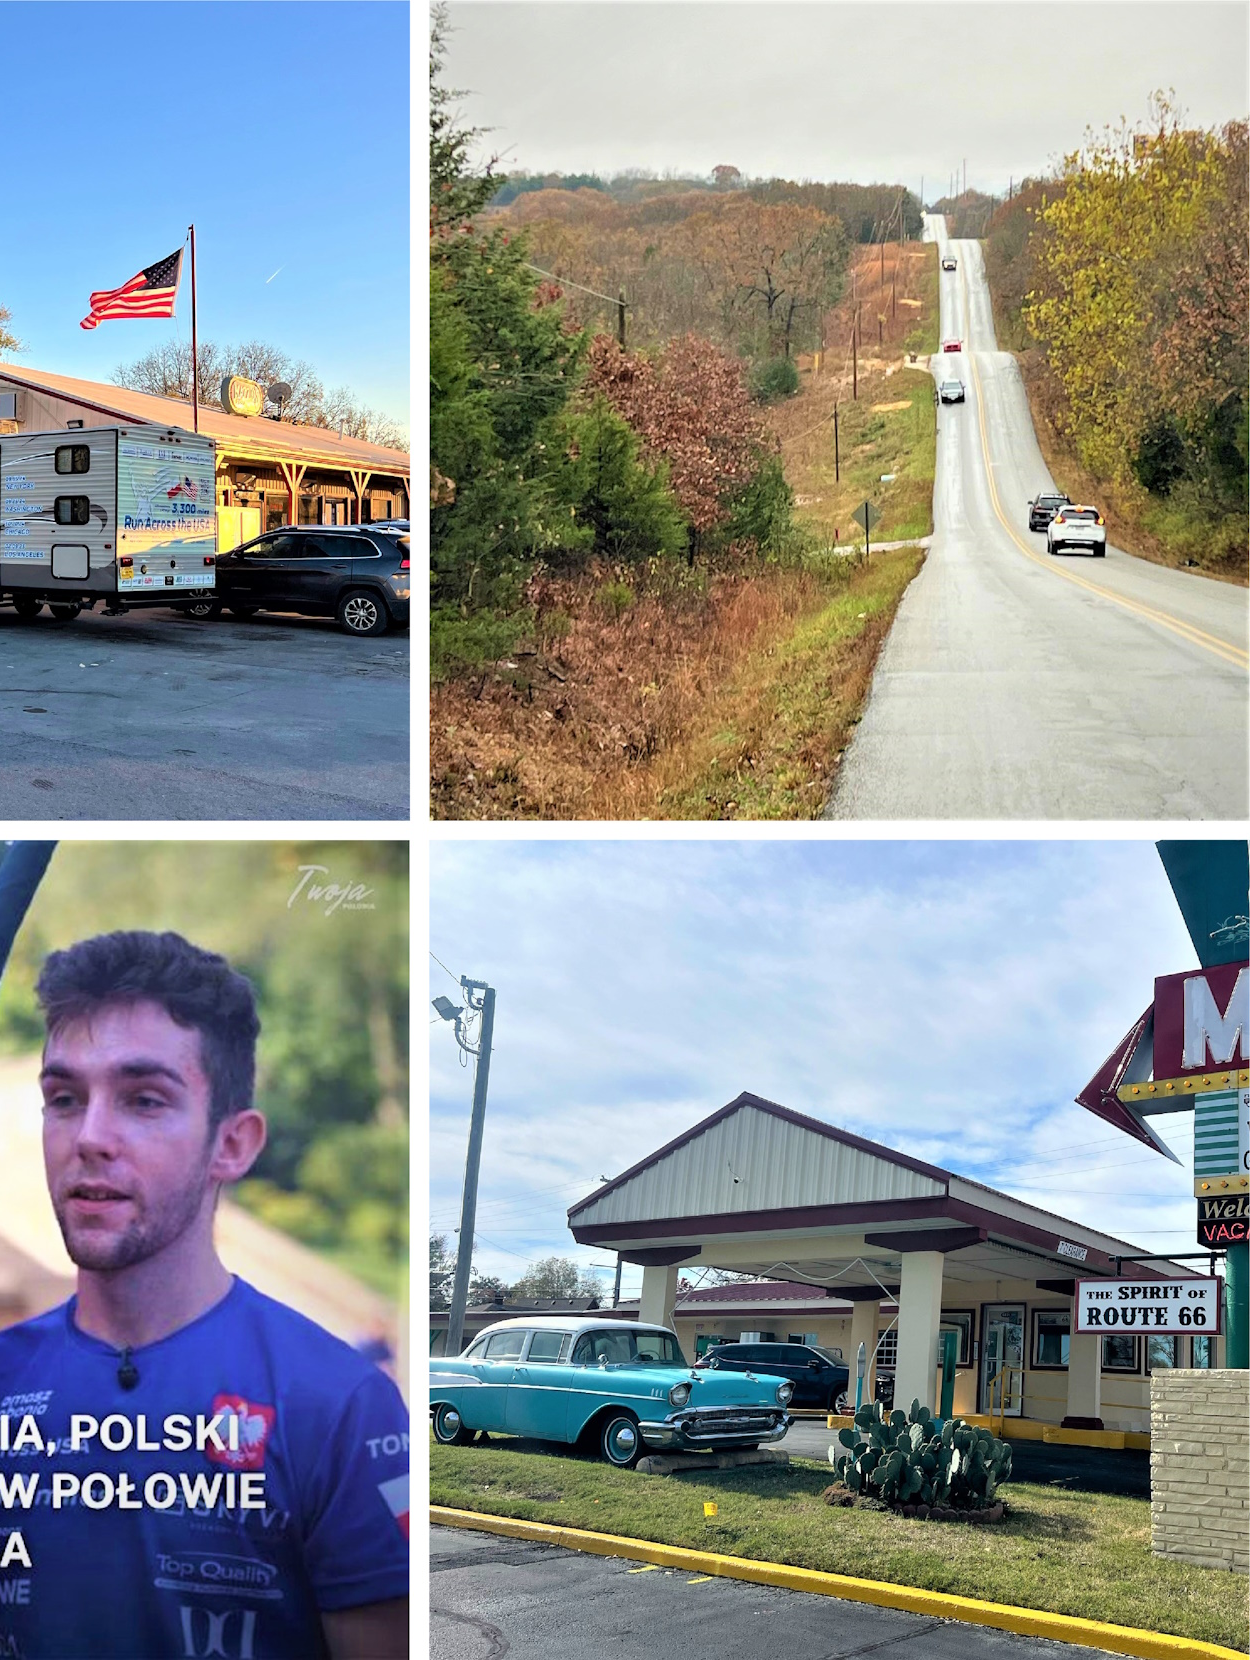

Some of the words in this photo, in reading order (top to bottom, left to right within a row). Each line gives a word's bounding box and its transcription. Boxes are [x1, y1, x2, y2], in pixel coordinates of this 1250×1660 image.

[171, 502, 196, 515] 3,300
[196, 507, 210, 515] miles
[124, 515, 144, 530] Run
[144, 517, 177, 531] Across
[177, 518, 192, 531] the
[193, 519, 210, 533] USA
[1086, 1290, 1113, 1300] THE
[1117, 1285, 1184, 1301] SPIRIT
[1187, 1289, 1208, 1300] OF
[1086, 1306, 1168, 1326] ROUTE
[1177, 1306, 1207, 1326] 66
[156, 1553, 195, 1578] Top
[200, 1560, 272, 1587] Quality
